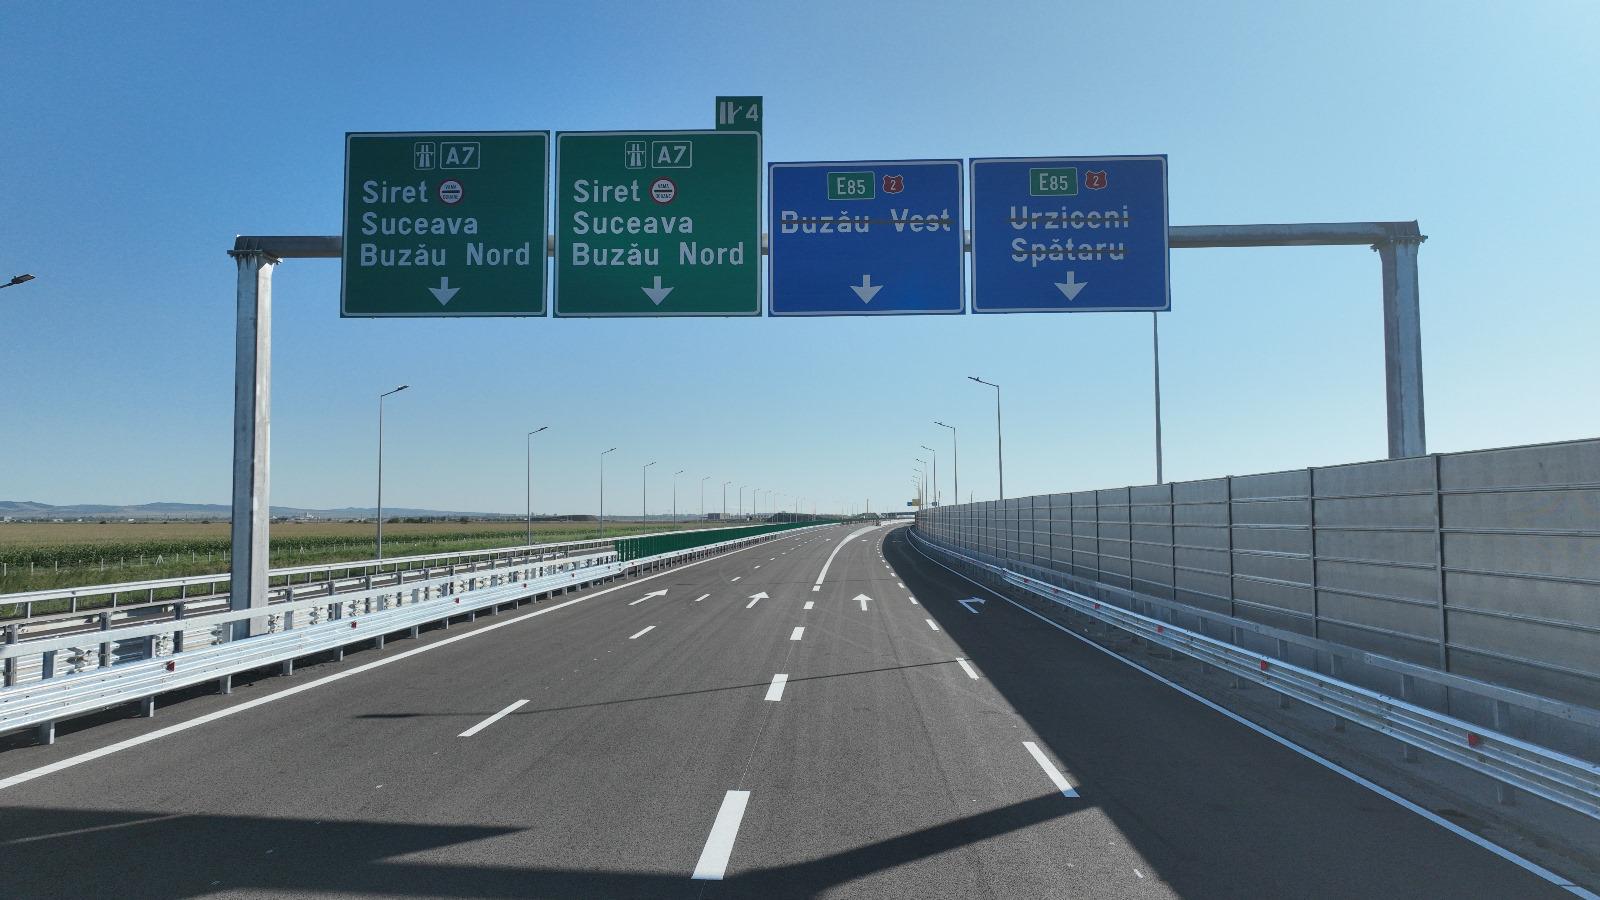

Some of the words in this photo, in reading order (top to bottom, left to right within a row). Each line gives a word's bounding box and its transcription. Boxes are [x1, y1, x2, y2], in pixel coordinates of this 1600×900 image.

[743, 104, 759, 122] 4
[446, 147, 475, 164] A7
[658, 146, 687, 163] A7
[363, 181, 428, 203] Siret
[574, 180, 641, 202] Siret
[837, 177, 865, 195] E85
[890, 179, 897, 191] 2
[1040, 173, 1067, 190] E85
[1092, 175, 1100, 187] 2
[362, 212, 478, 235] Suceava
[573, 211, 693, 234] Suceava
[781, 210, 869, 234] Buzău
[890, 208, 951, 233] Vest
[361, 242, 446, 267] Buzău
[466, 242, 530, 266] Nord
[572, 242, 659, 266] Buzău
[680, 242, 744, 266] Nord
[1011, 237, 1124, 267] Spătaru
